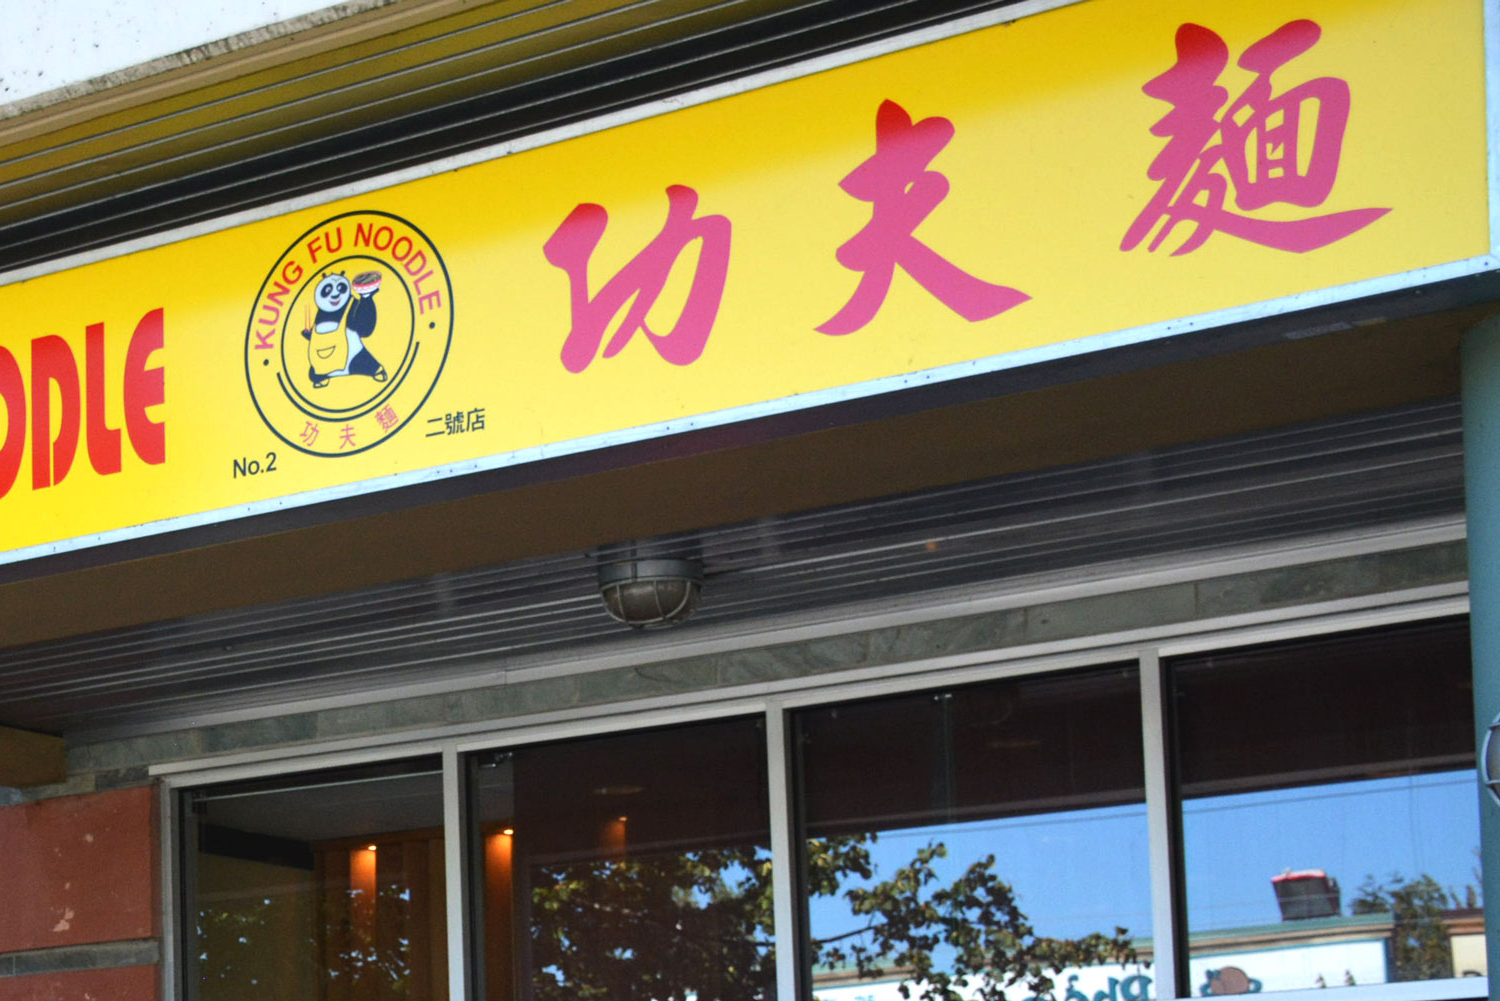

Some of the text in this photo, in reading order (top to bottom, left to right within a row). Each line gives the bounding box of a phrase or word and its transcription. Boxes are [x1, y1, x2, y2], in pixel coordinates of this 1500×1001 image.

[254, 223, 442, 350] KUNG FU NOODLE
[233, 451, 277, 479] No.2
